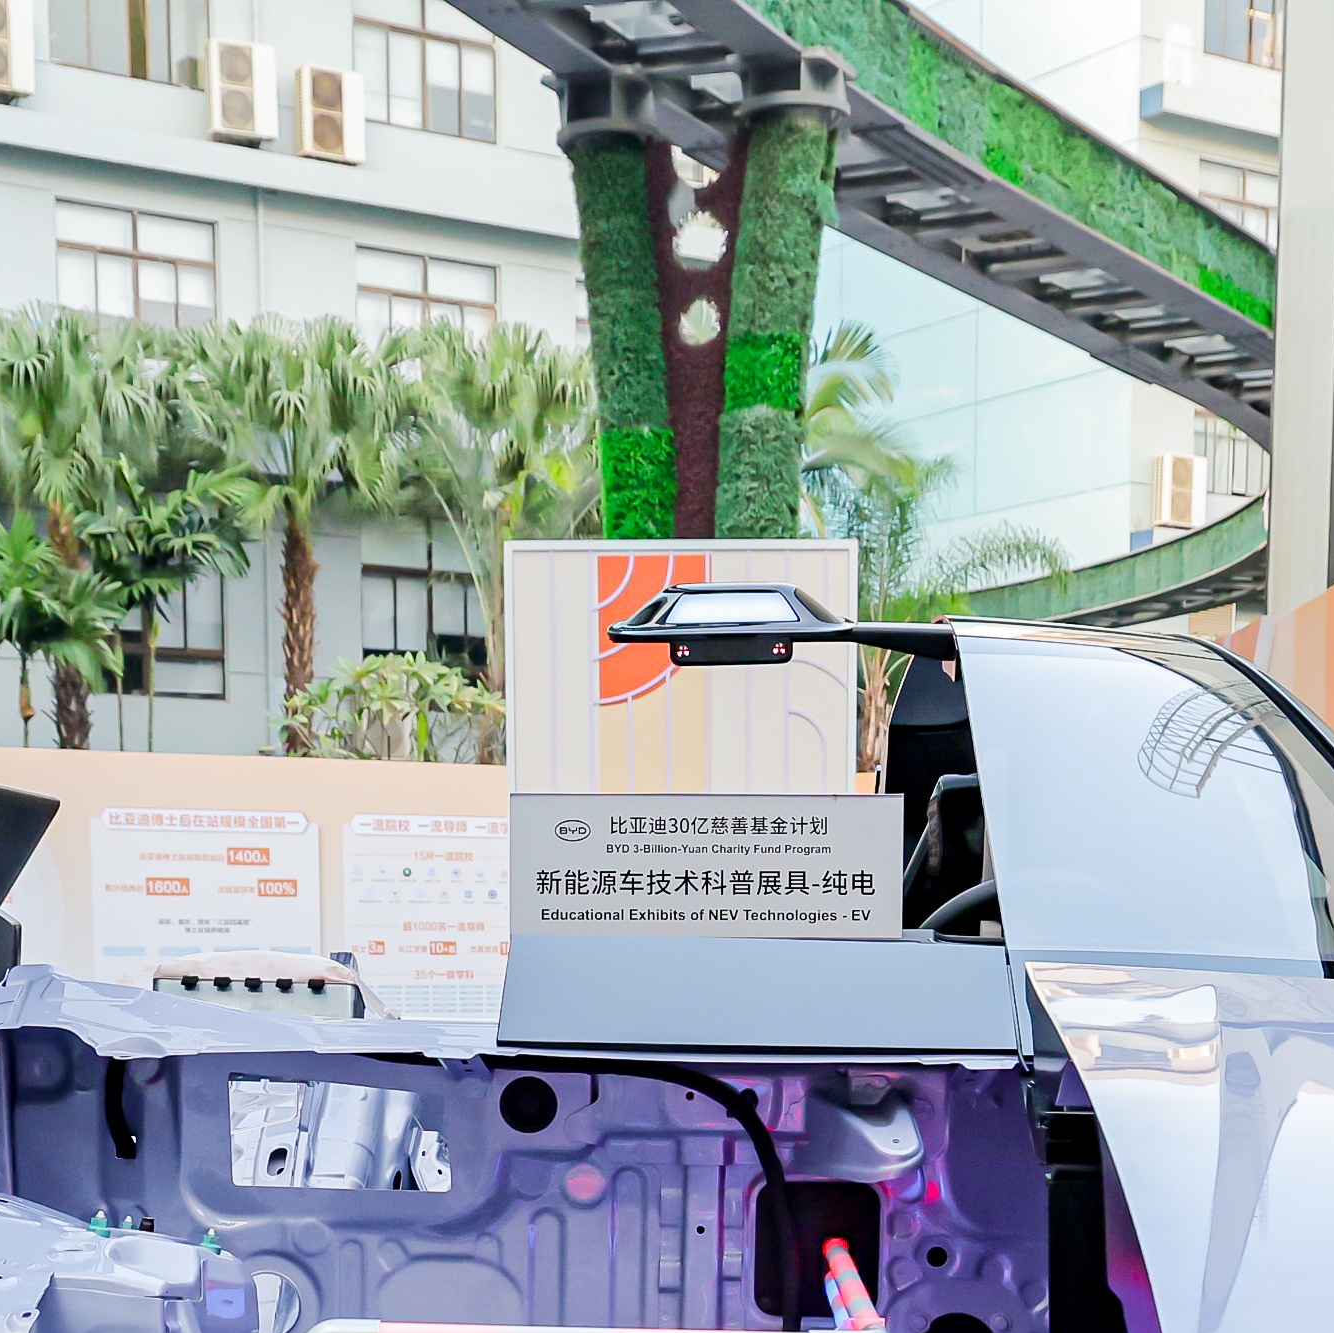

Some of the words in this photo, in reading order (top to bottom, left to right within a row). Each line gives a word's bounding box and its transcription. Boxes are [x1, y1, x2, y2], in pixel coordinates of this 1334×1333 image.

[610, 815, 828, 836] 比亚迪30亿慈善基金计划
[606, 844, 630, 854] BYD
[633, 844, 708, 854] 3-Billion-Yuan
[711, 844, 750, 856] Charity
[753, 844, 781, 854] Fund
[784, 844, 832, 856] Program
[259, 882, 296, 896] 100%
[536, 869, 876, 896] 新能源车技术科普展具-纯电
[541, 908, 624, 921] Educational
[629, 908, 686, 921] Exhibits
[690, 909, 704, 921] of
[708, 909, 739, 921] NEV
[743, 909, 838, 924] Technologies
[851, 910, 871, 921] EV
